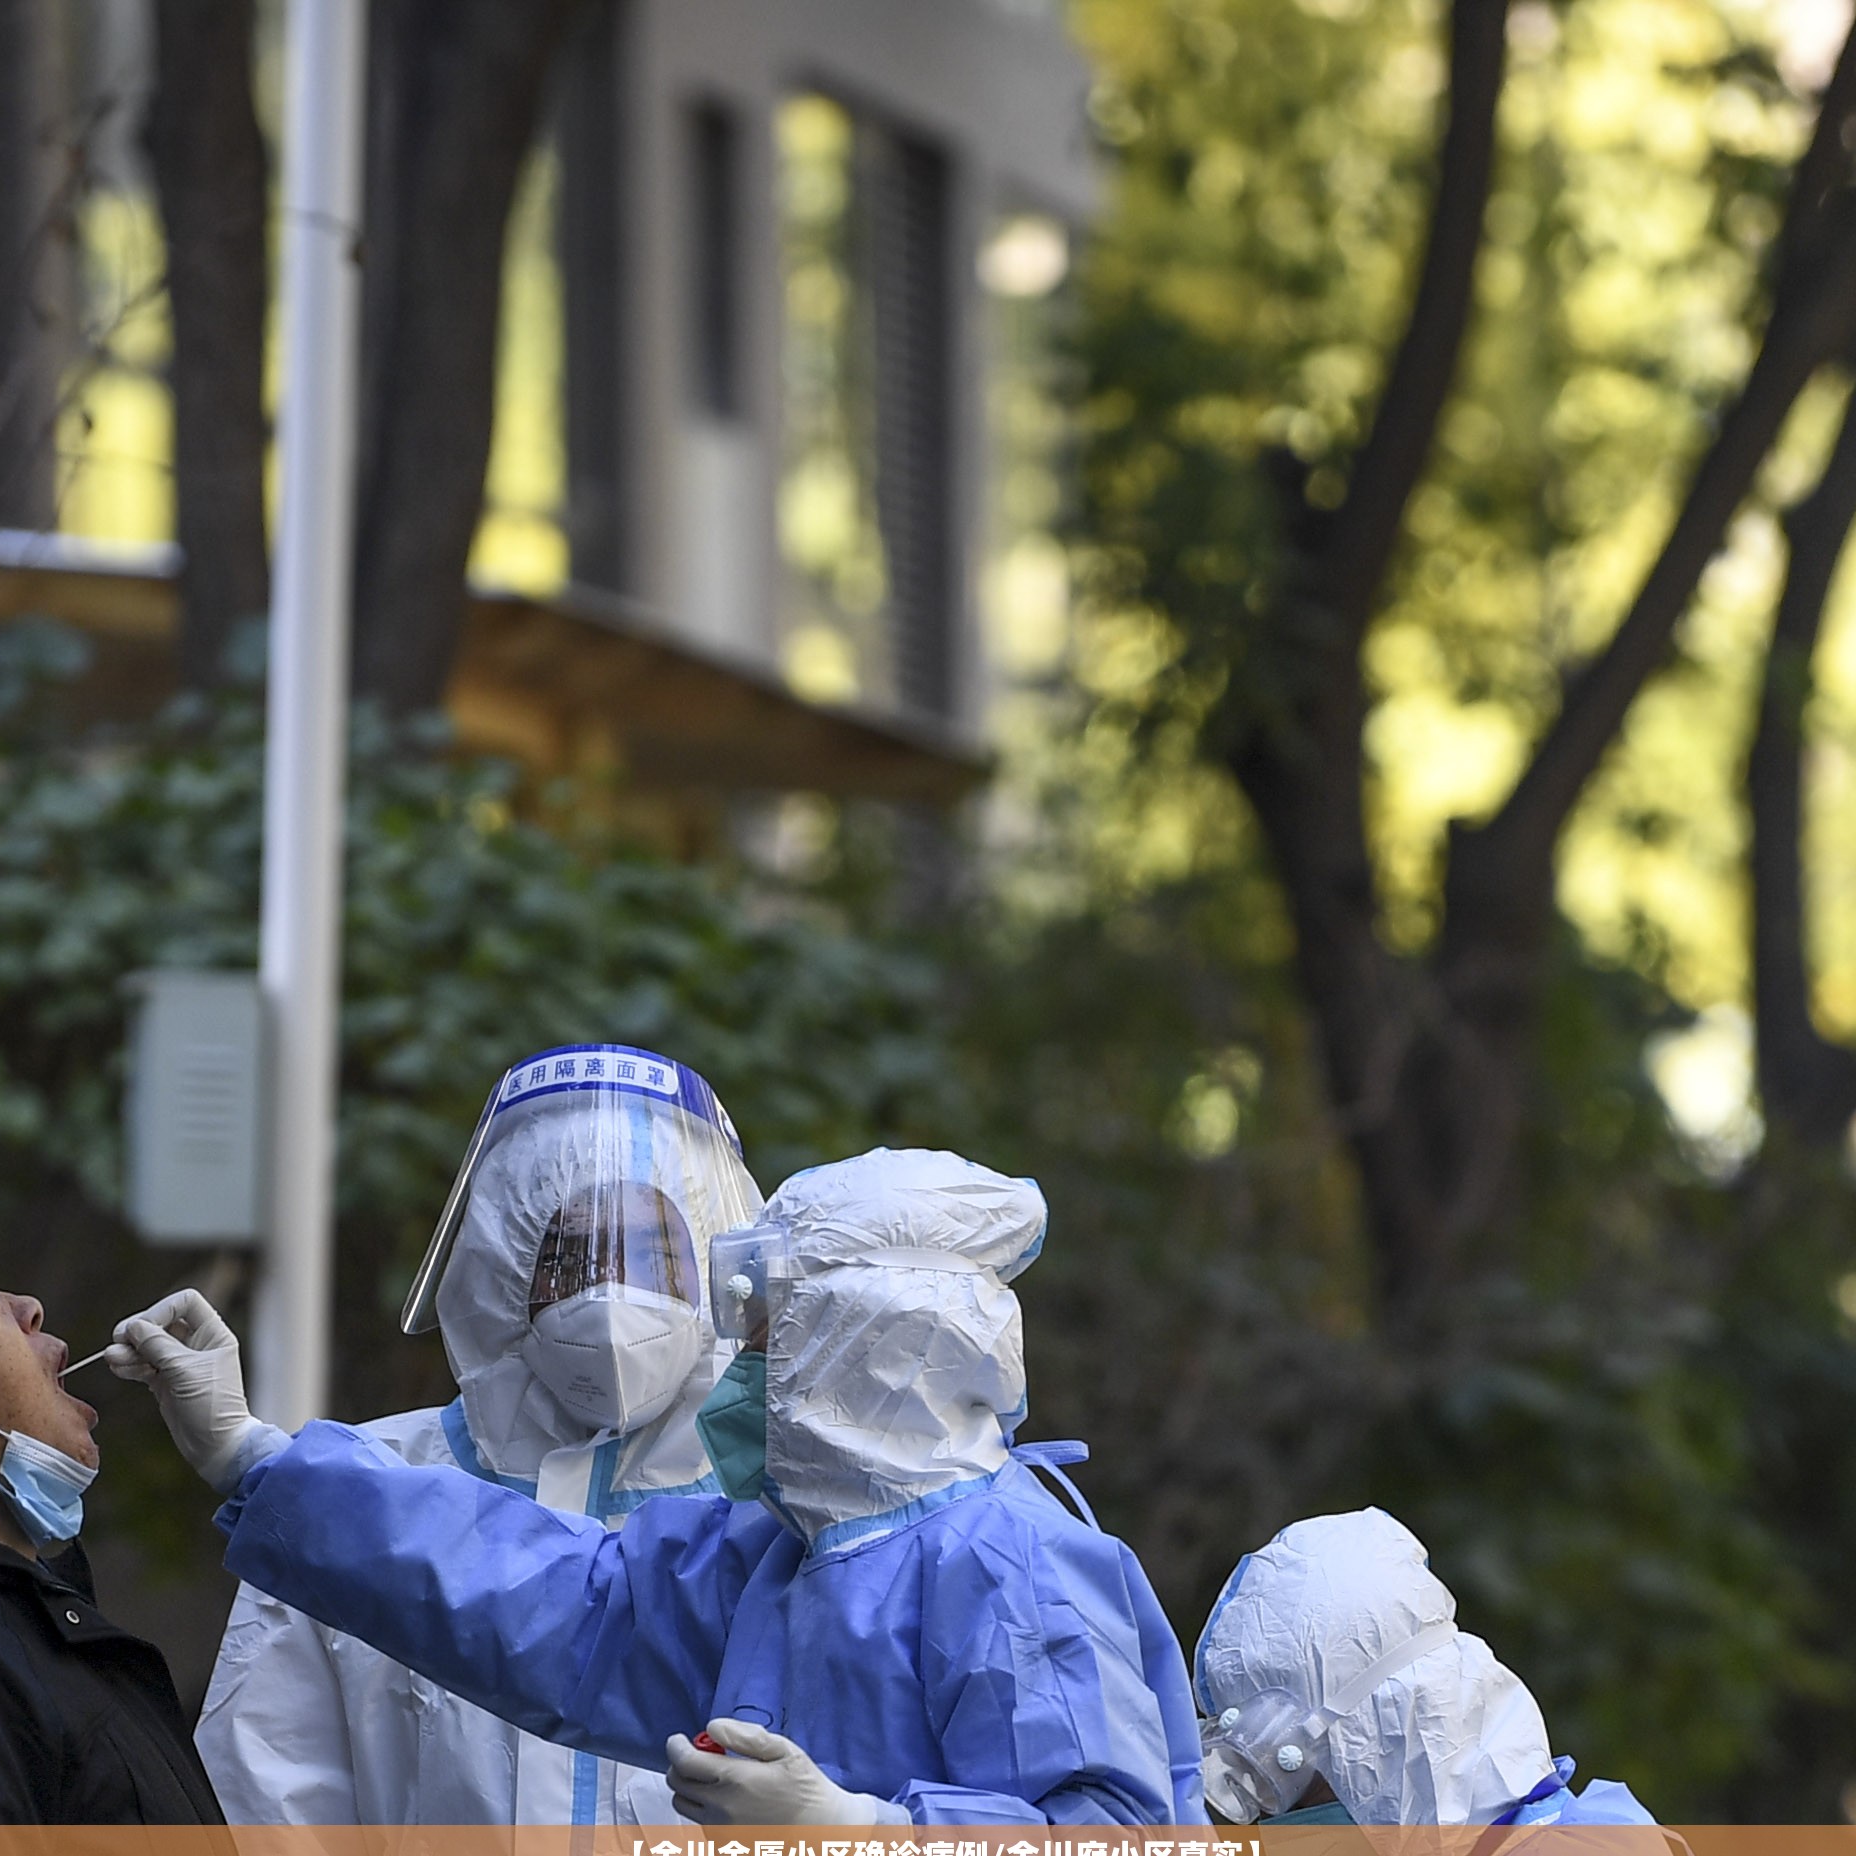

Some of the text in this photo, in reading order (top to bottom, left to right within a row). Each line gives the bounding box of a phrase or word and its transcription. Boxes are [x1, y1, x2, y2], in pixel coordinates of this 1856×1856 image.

[507, 1057, 666, 1096] 医用隔离面罩
